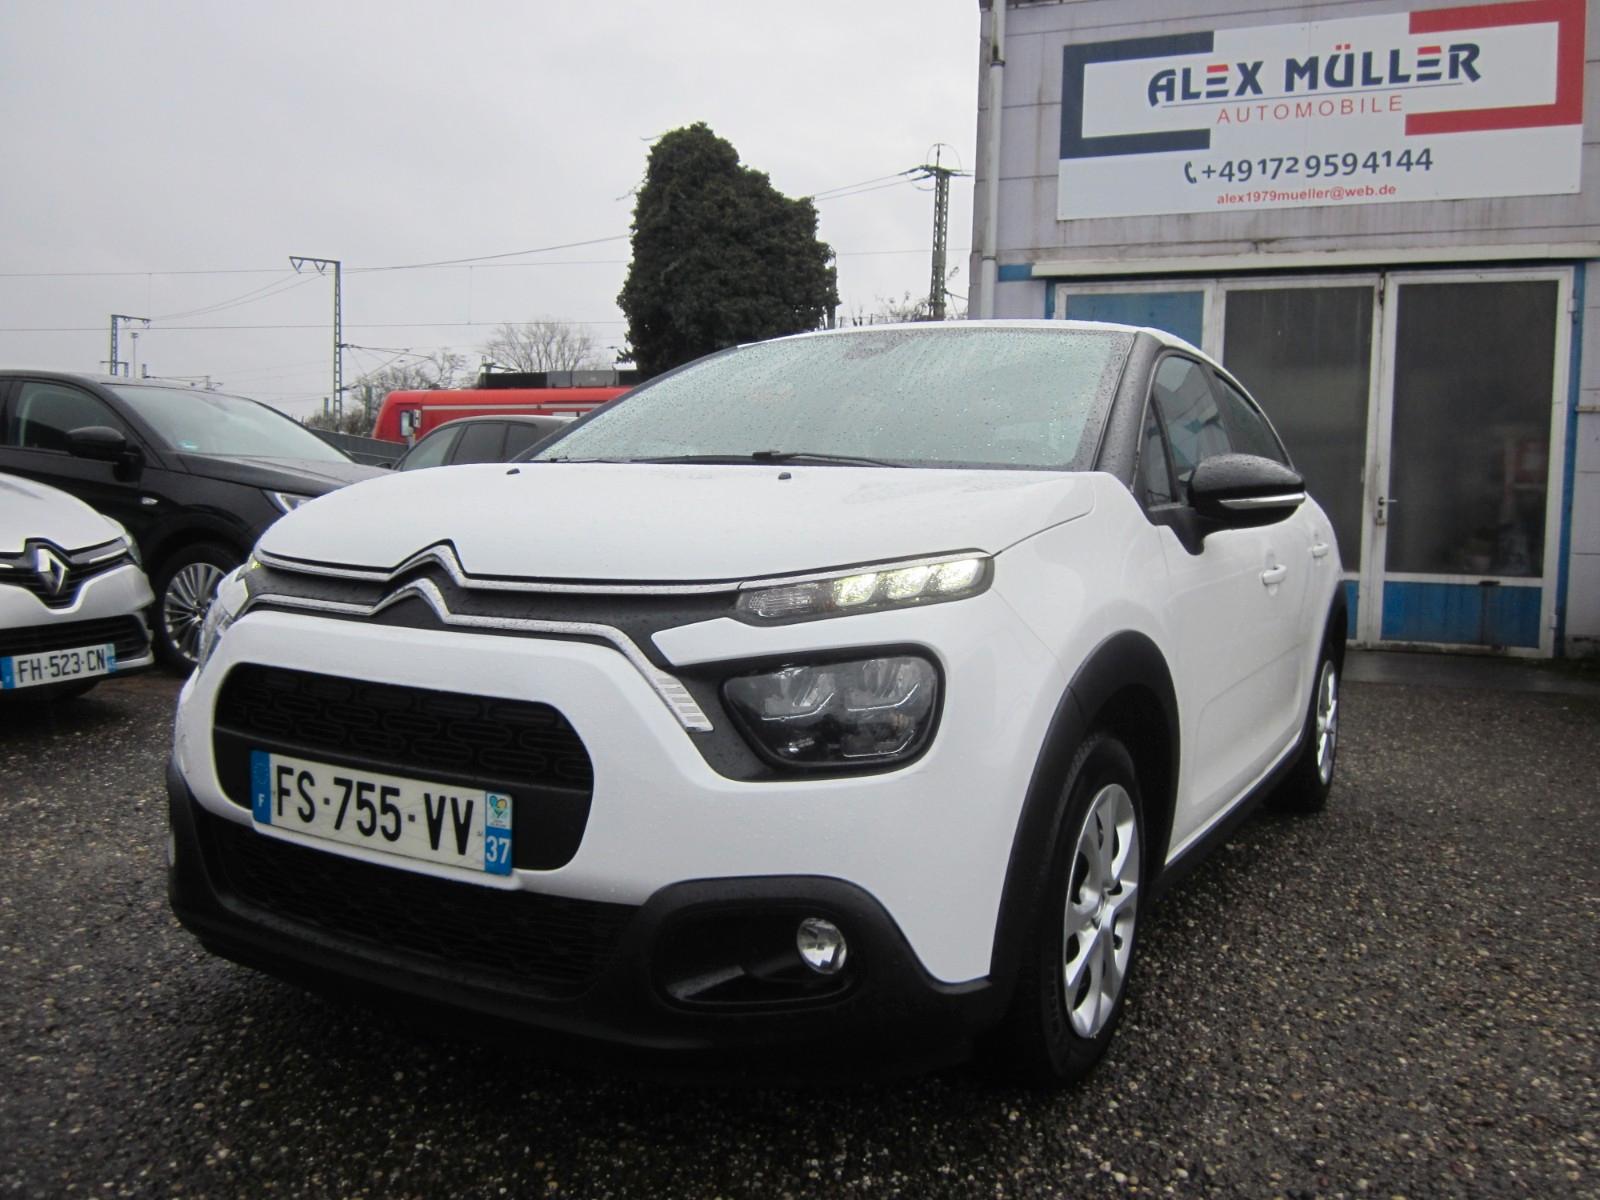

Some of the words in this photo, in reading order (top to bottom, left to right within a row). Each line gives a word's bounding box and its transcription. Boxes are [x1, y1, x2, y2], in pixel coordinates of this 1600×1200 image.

[1148, 60, 1264, 107] ALEX
[1284, 43, 1481, 92] MÜLLER
[1216, 95, 1403, 124] AUTOMOBILE
[1216, 184, 1397, 205] alex1979mueller@web.de
[258, 793, 265, 807] F
[276, 764, 474, 856] FS-755-VV
[486, 835, 511, 864] 37
